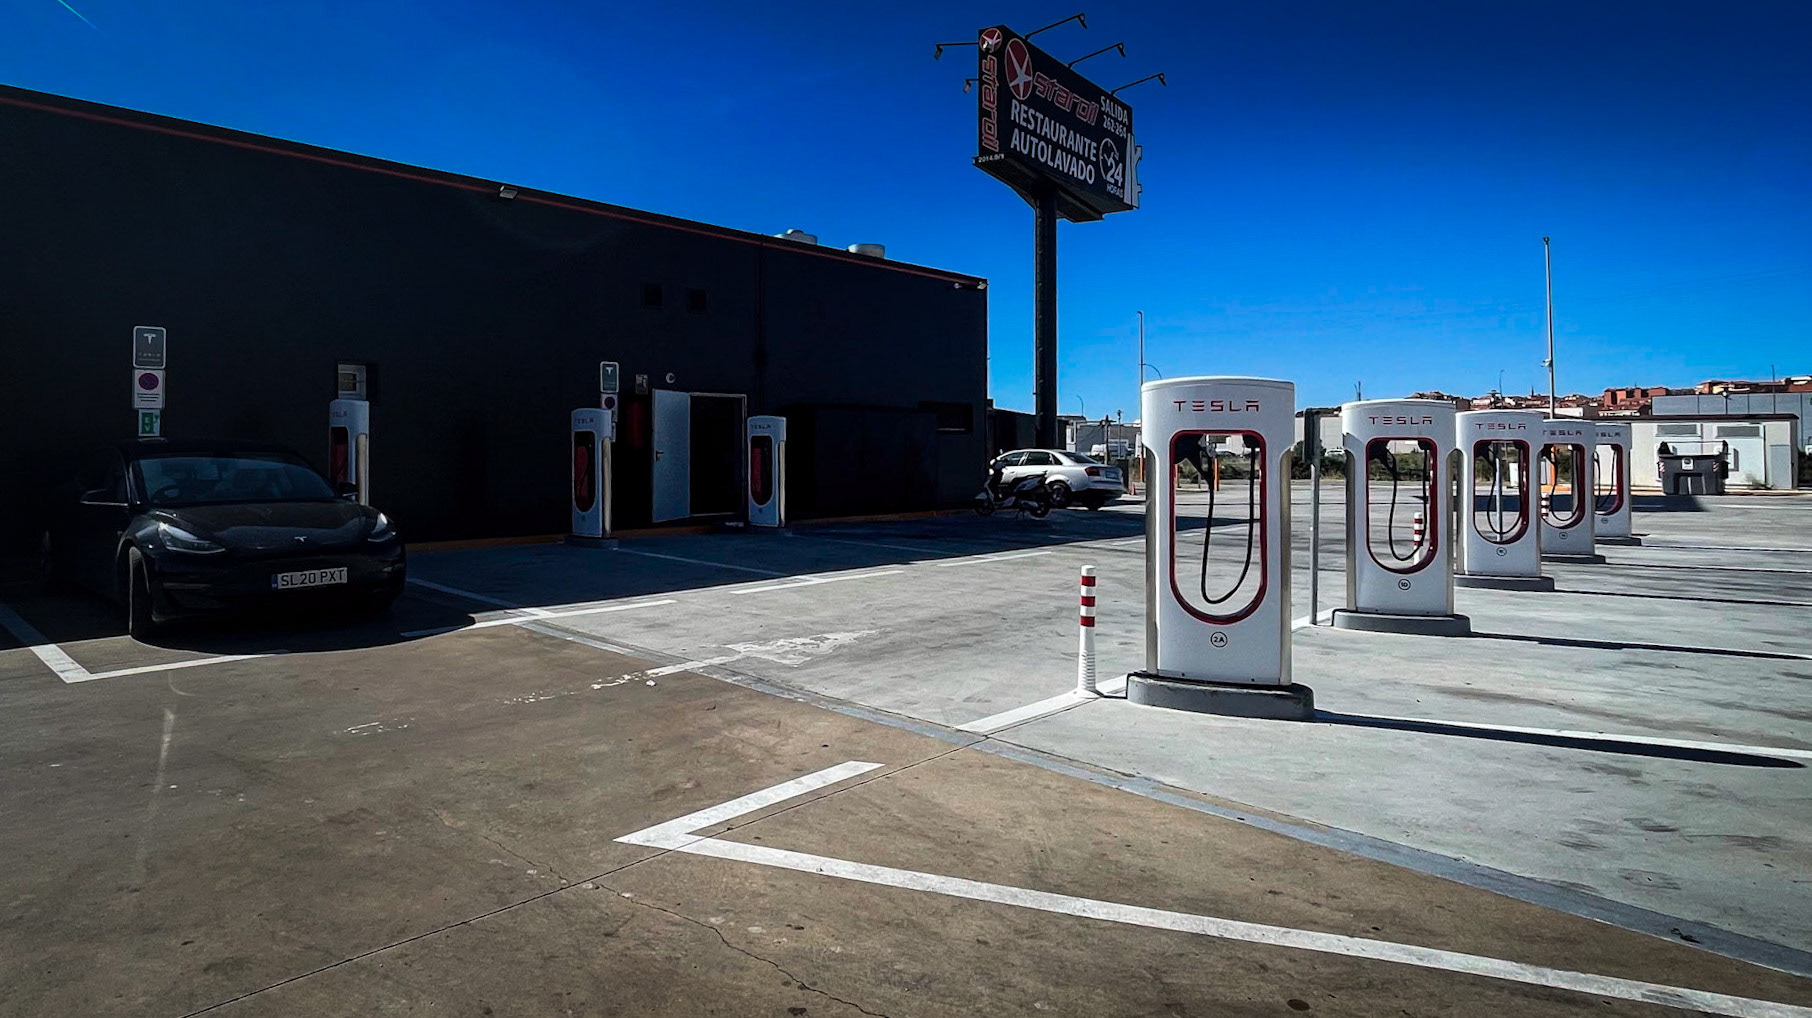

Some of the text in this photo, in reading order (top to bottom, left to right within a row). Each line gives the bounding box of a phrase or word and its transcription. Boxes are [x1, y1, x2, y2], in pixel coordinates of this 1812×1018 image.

[1034, 71, 1100, 126] staroil
[1100, 95, 1129, 126] SALIDA
[1010, 99, 1098, 162] RESTAURANTE
[1010, 128, 1096, 185] AUTOLAVADO
[1106, 157, 1123, 187] 24
[1173, 400, 1260, 412] TESLA
[1368, 415, 1433, 425] TESLA
[1475, 423, 1527, 431] TESLA
[320, 569, 345, 583] PXT
